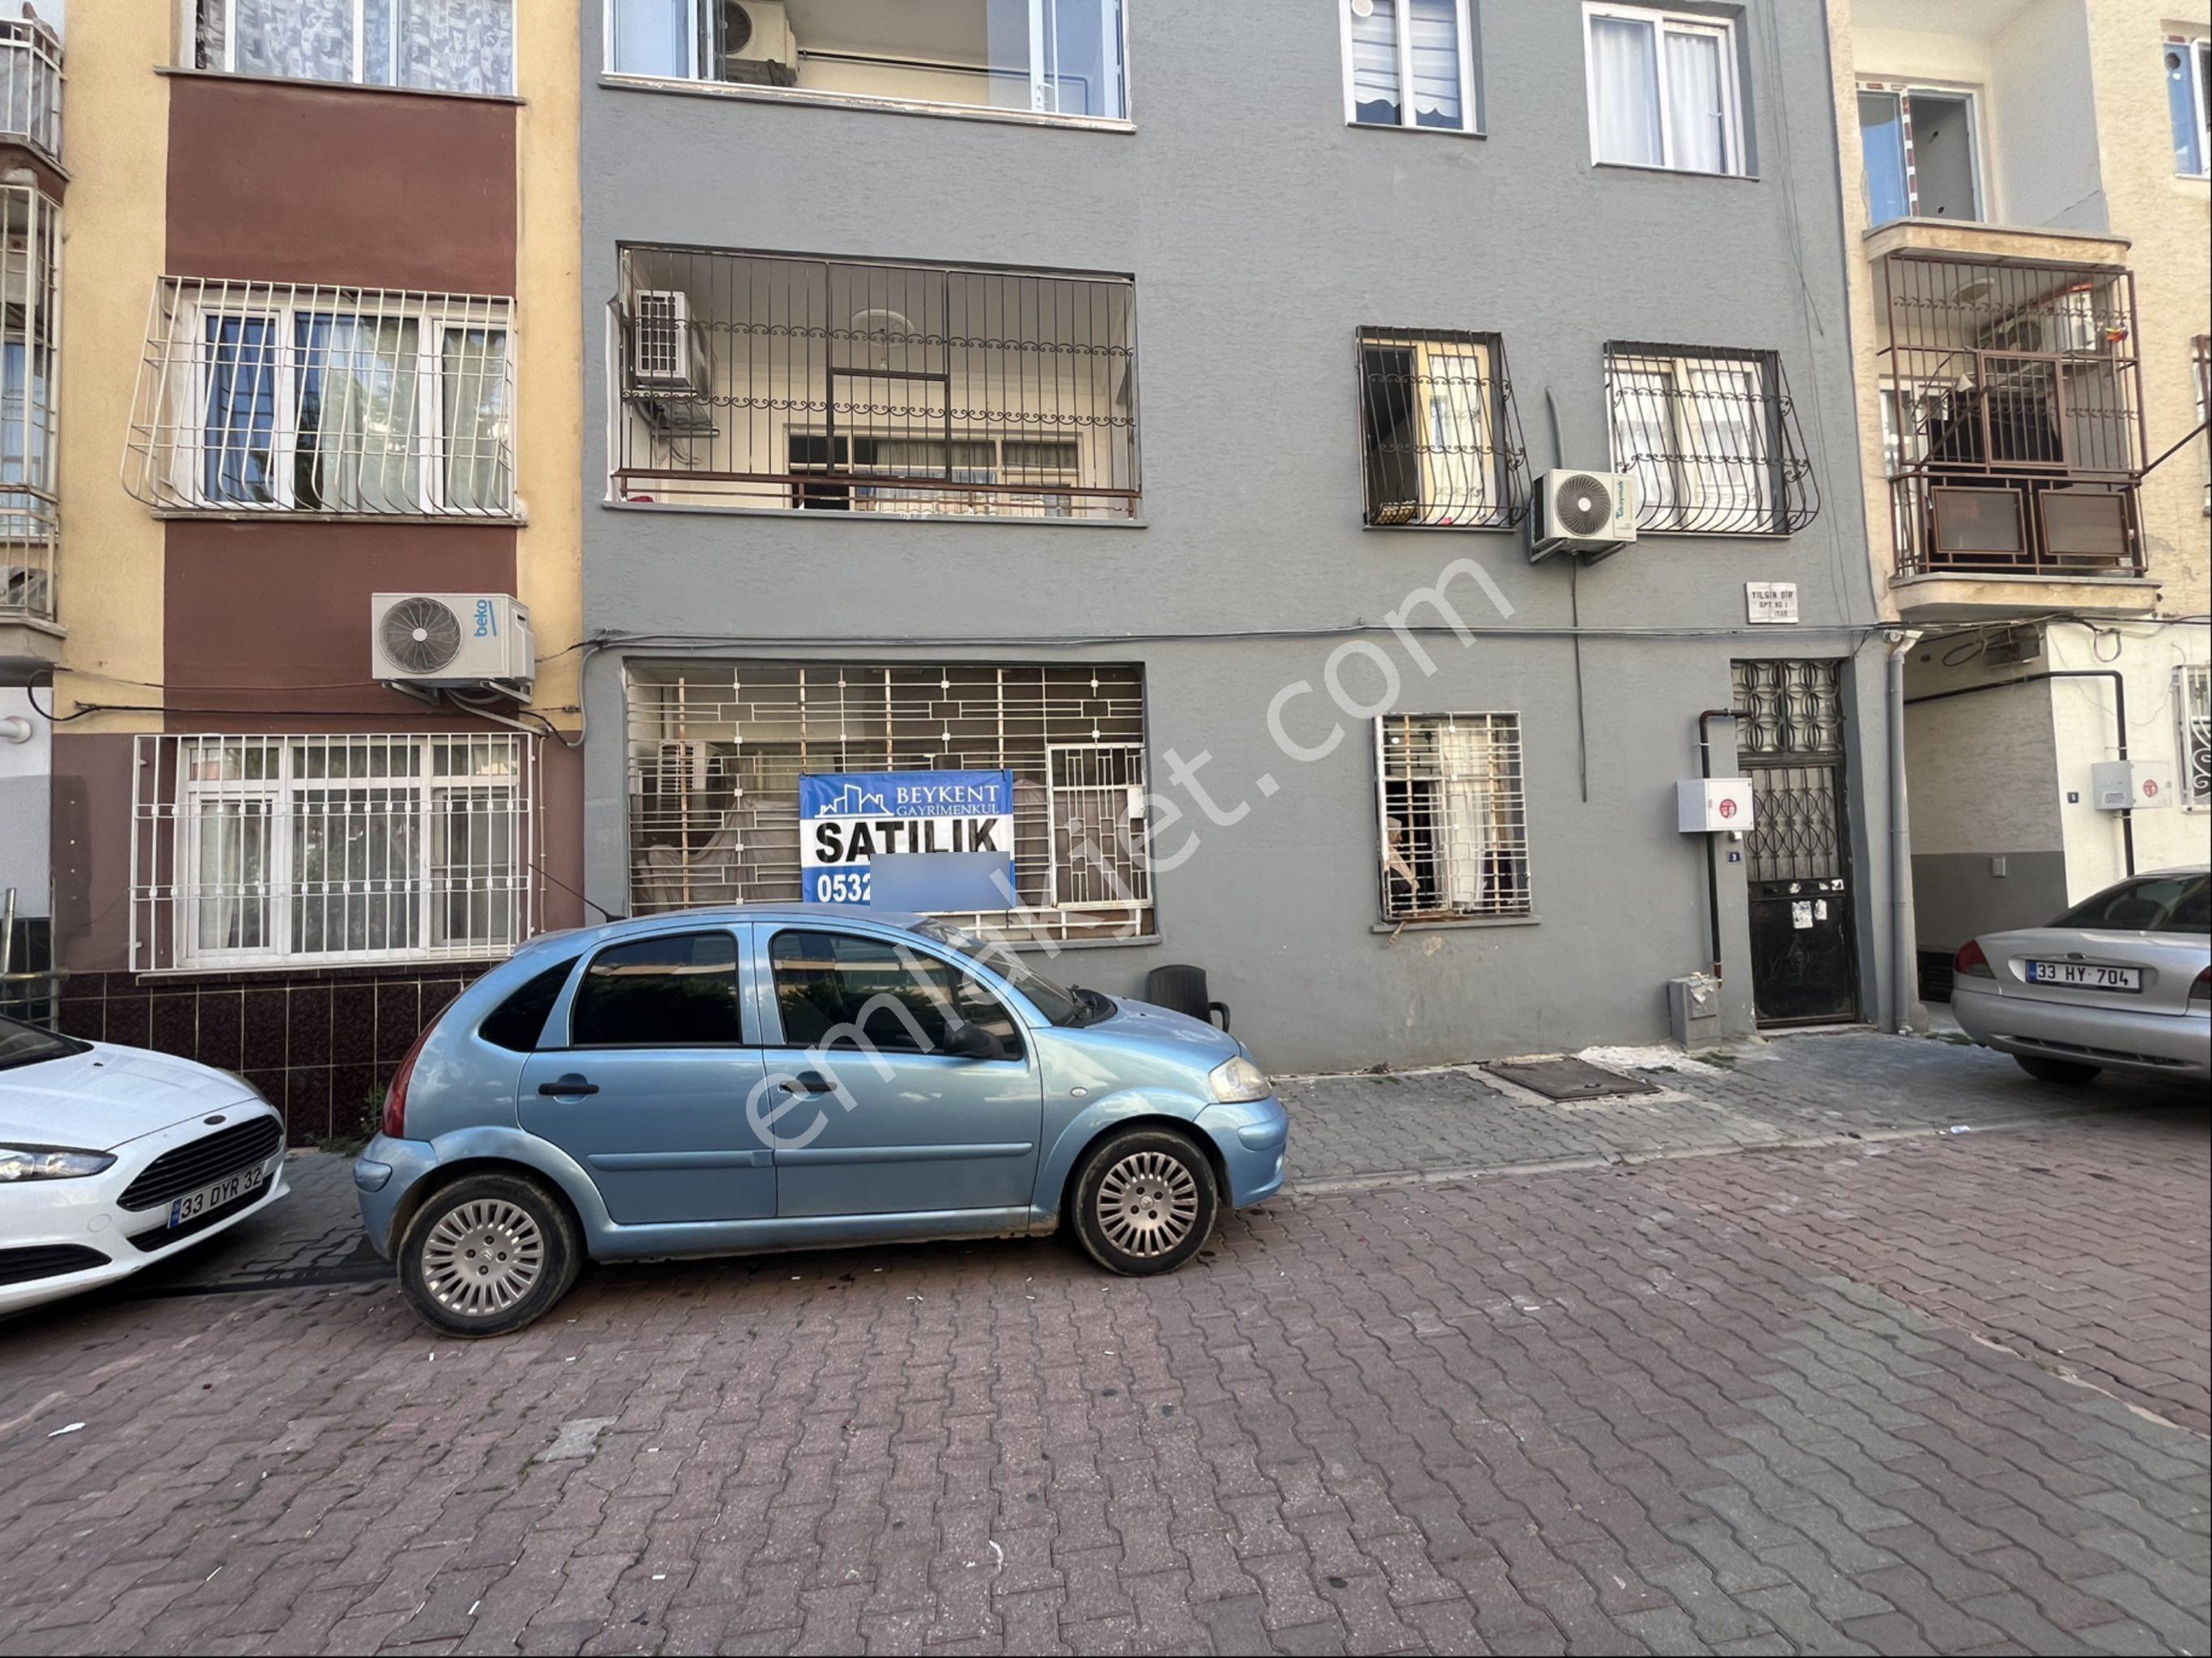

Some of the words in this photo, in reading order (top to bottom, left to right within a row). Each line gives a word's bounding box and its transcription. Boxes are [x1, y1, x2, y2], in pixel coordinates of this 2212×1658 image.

[474, 600, 487, 637] beko
[896, 785, 1000, 804] BEYKENT
[896, 803, 1000, 816] GAYRİMENKUL
[815, 818, 1000, 863] SATILIK
[2038, 964, 2056, 979] 33
[2066, 966, 2086, 982] HY
[2097, 969, 2129, 986] 704
[181, 1194, 204, 1218] 33
[210, 1177, 239, 1206] DYR
[244, 1167, 261, 1189] 32
